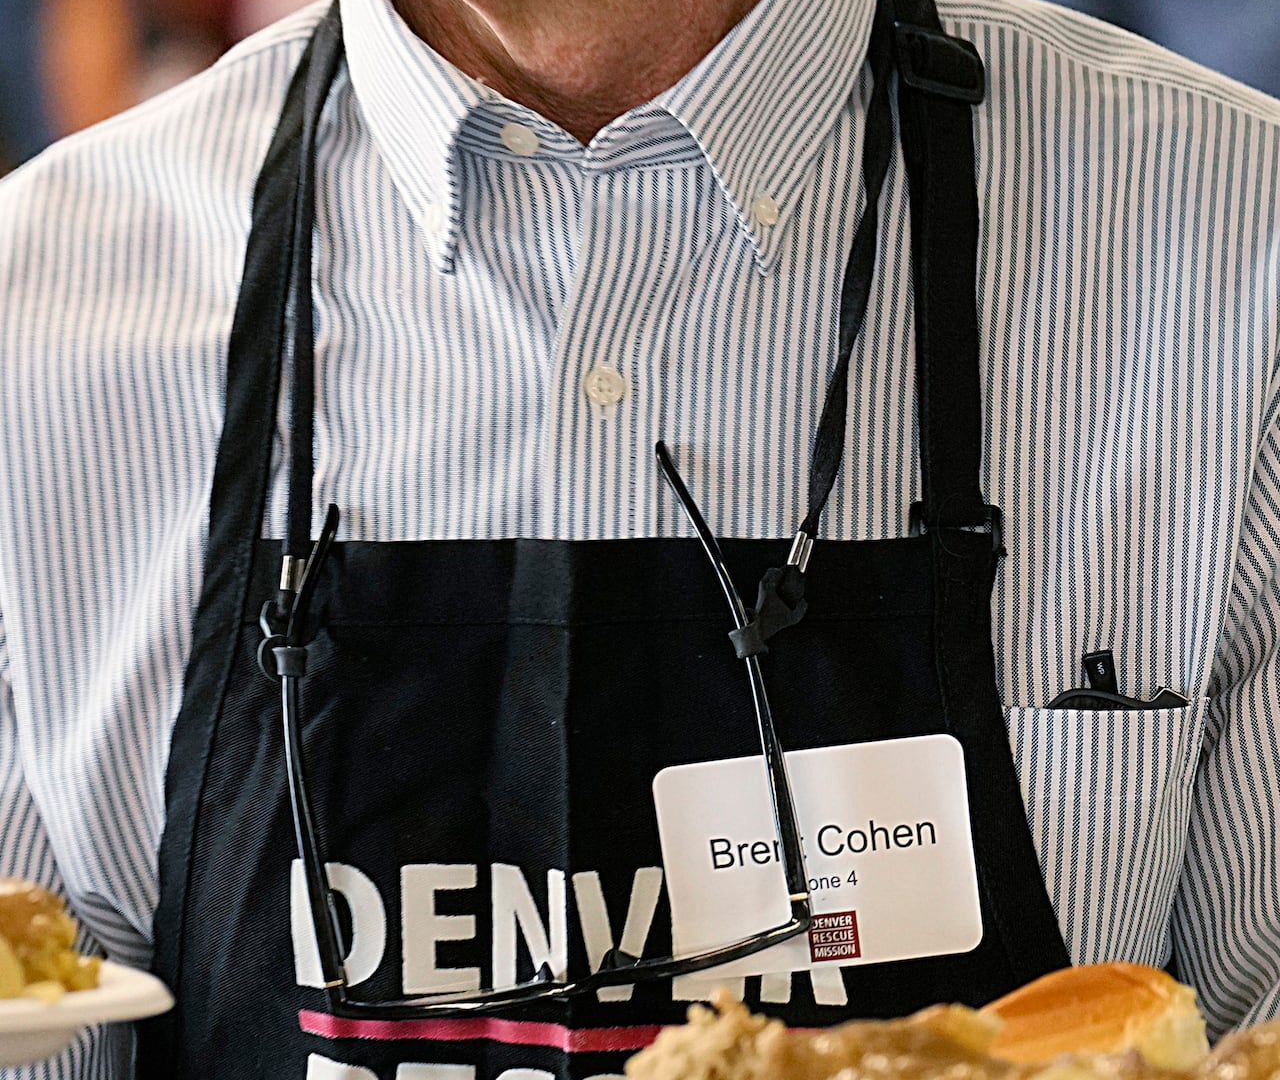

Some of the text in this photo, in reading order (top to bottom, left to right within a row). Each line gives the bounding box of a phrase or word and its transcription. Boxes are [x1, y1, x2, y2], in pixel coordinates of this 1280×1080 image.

[710, 820, 936, 869] Bre Cohen
[807, 869, 858, 891] one 4
[290, 857, 849, 1006] DENV
[812, 930, 855, 944] RESCUE
[814, 944, 856, 959] MISSION
